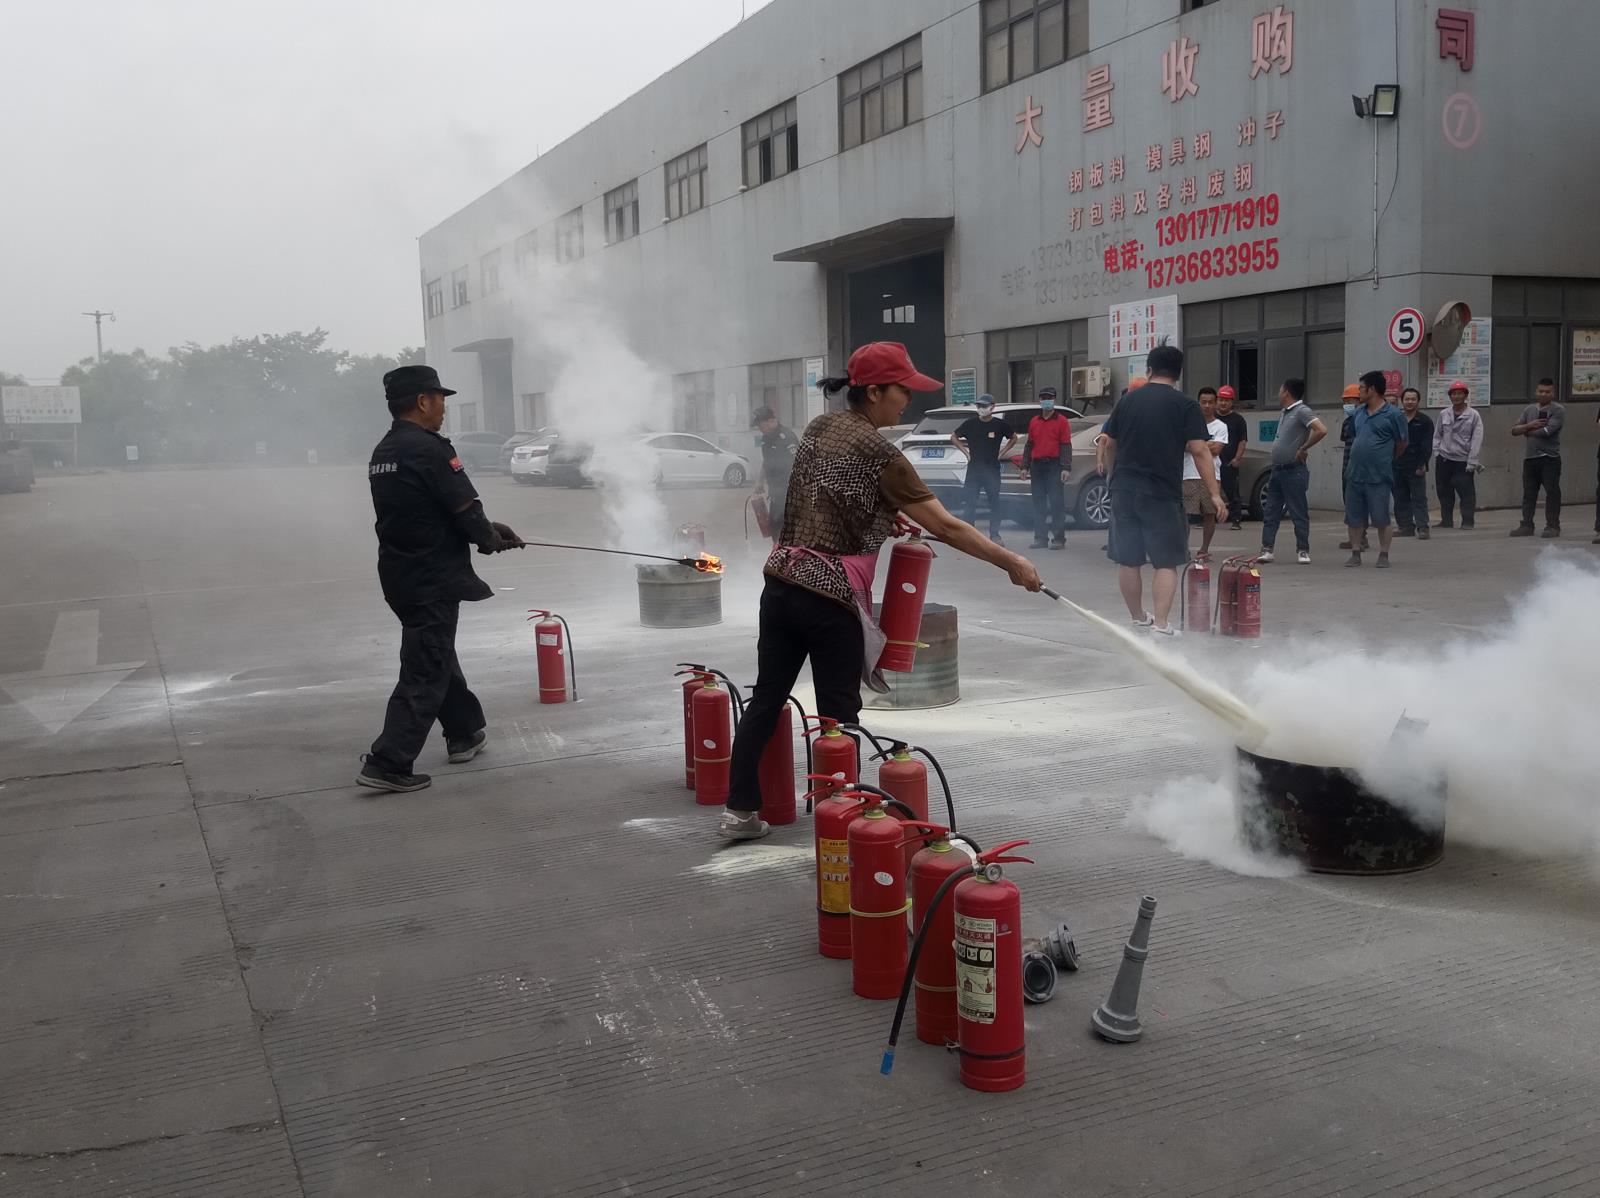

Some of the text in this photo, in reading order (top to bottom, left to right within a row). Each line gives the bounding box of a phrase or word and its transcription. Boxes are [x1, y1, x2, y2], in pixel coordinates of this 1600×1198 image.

[1436, 8, 1474, 71] 司
[1015, 6, 1294, 154] 大量收购
[1069, 109, 1284, 194] 钢板料 模具钢 冲子
[1069, 162, 1253, 232] 打包料及各料废钢
[1155, 193, 1279, 247] 13017771919
[1145, 238, 1279, 289] 13736833955
[1398, 317, 1415, 345] 5
